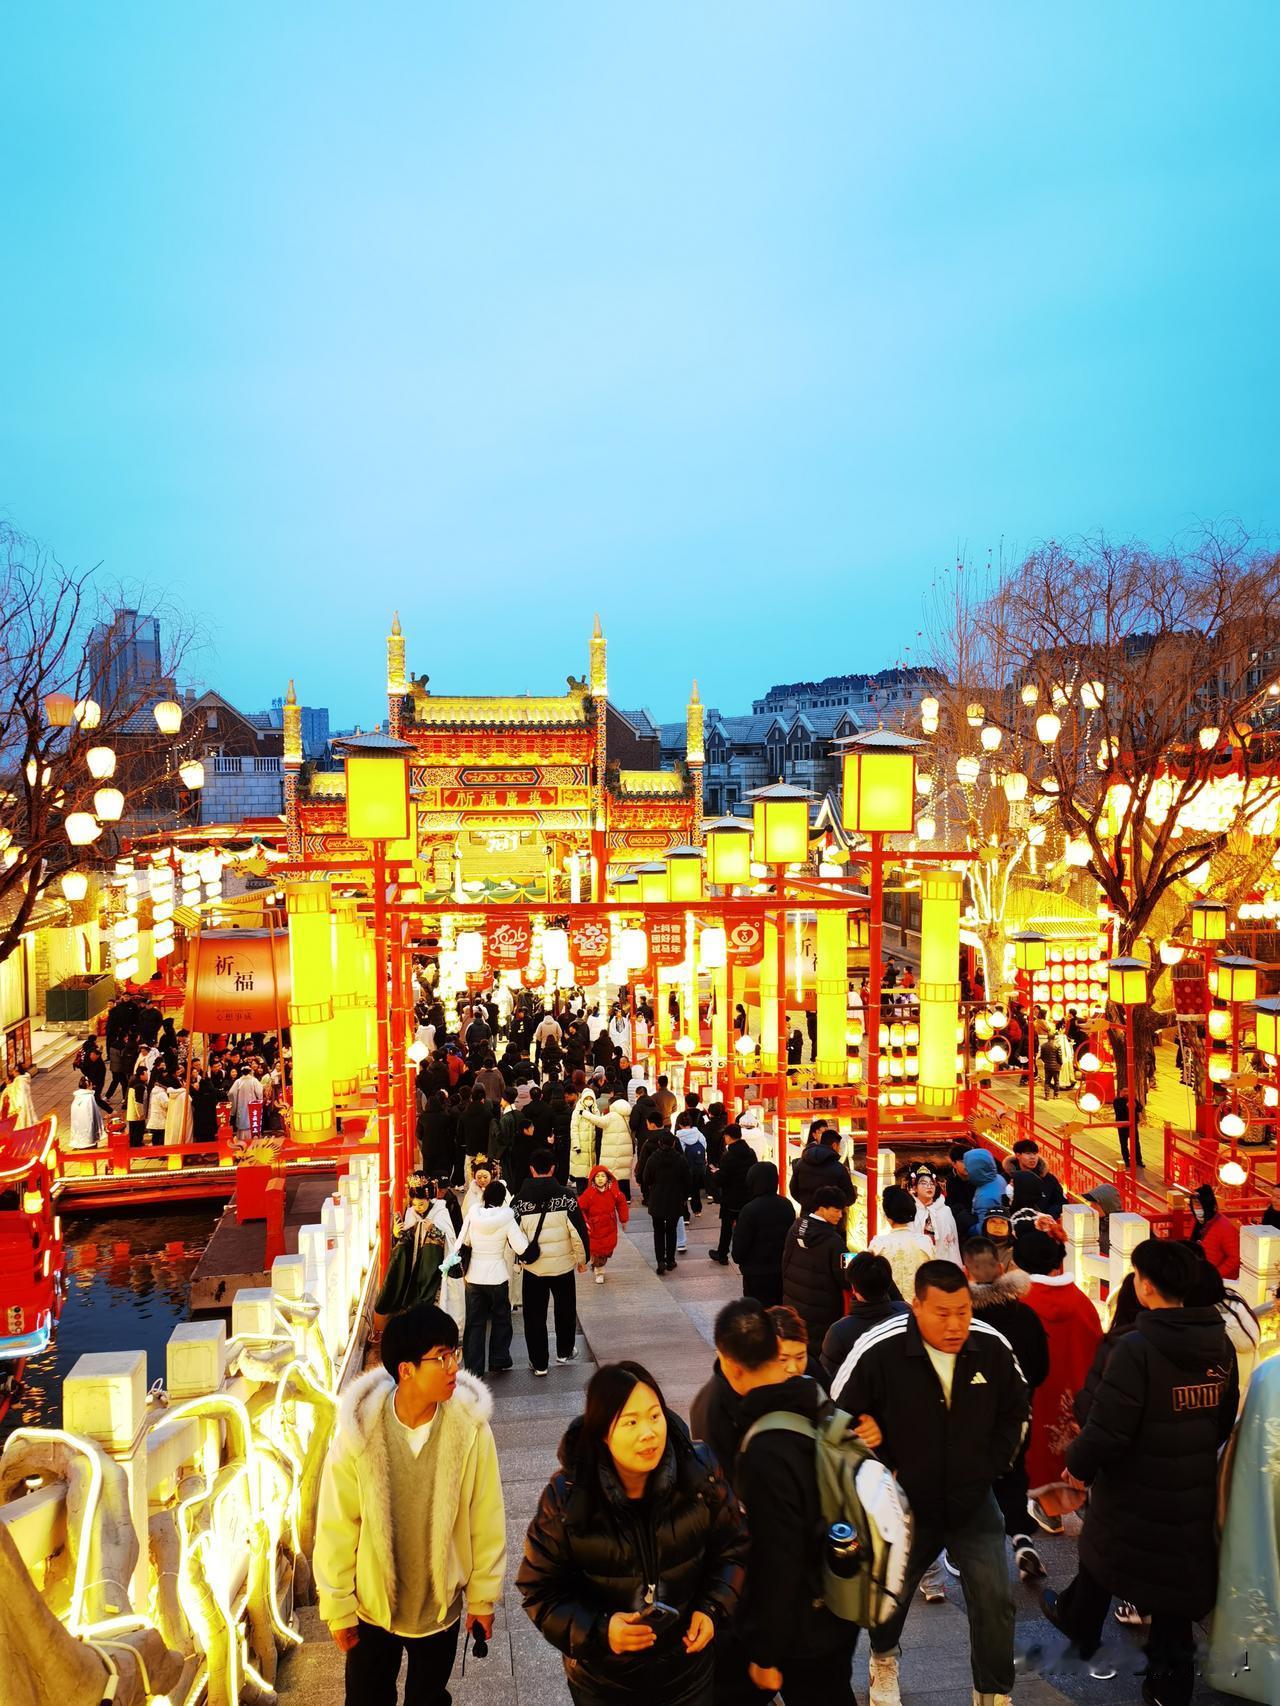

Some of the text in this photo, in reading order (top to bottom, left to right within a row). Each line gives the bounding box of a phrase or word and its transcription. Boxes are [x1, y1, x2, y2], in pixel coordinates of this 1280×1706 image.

[489, 926, 528, 950] 2026
[651, 944, 681, 954] 过马年
[215, 954, 254, 992] 祈福
